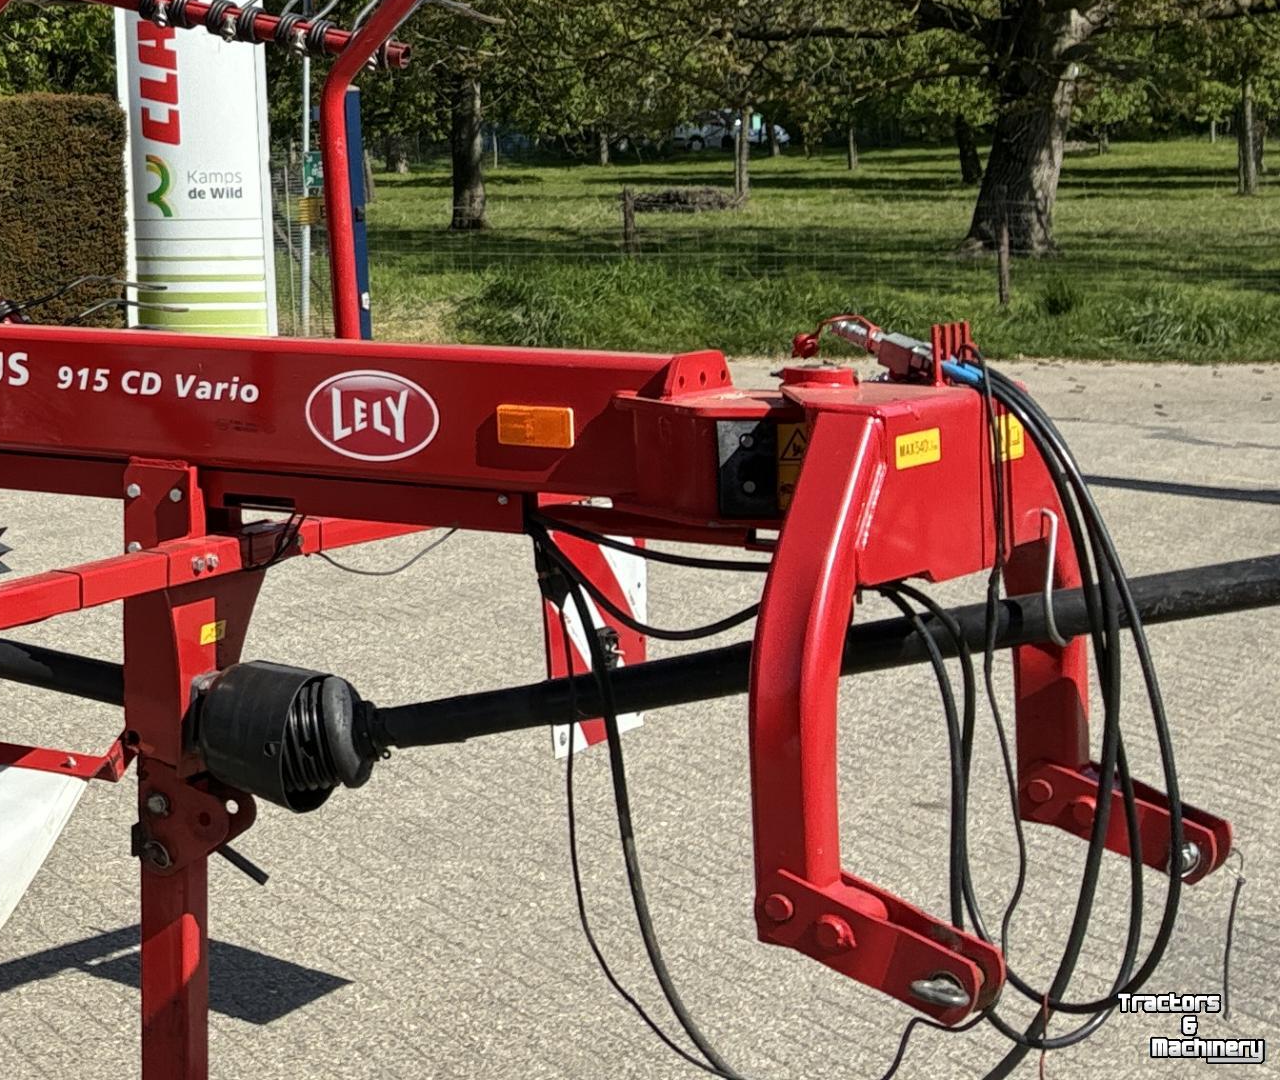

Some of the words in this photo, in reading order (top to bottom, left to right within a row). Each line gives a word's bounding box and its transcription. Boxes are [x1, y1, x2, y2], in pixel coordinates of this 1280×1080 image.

[137, 19, 181, 145] CLA
[186, 169, 243, 185] Kamps
[187, 187, 207, 200] de
[209, 186, 243, 200] Wild
[56, 366, 111, 393] 915
[120, 370, 163, 395] CD
[175, 373, 260, 403] Vario
[330, 387, 410, 444] LELY
